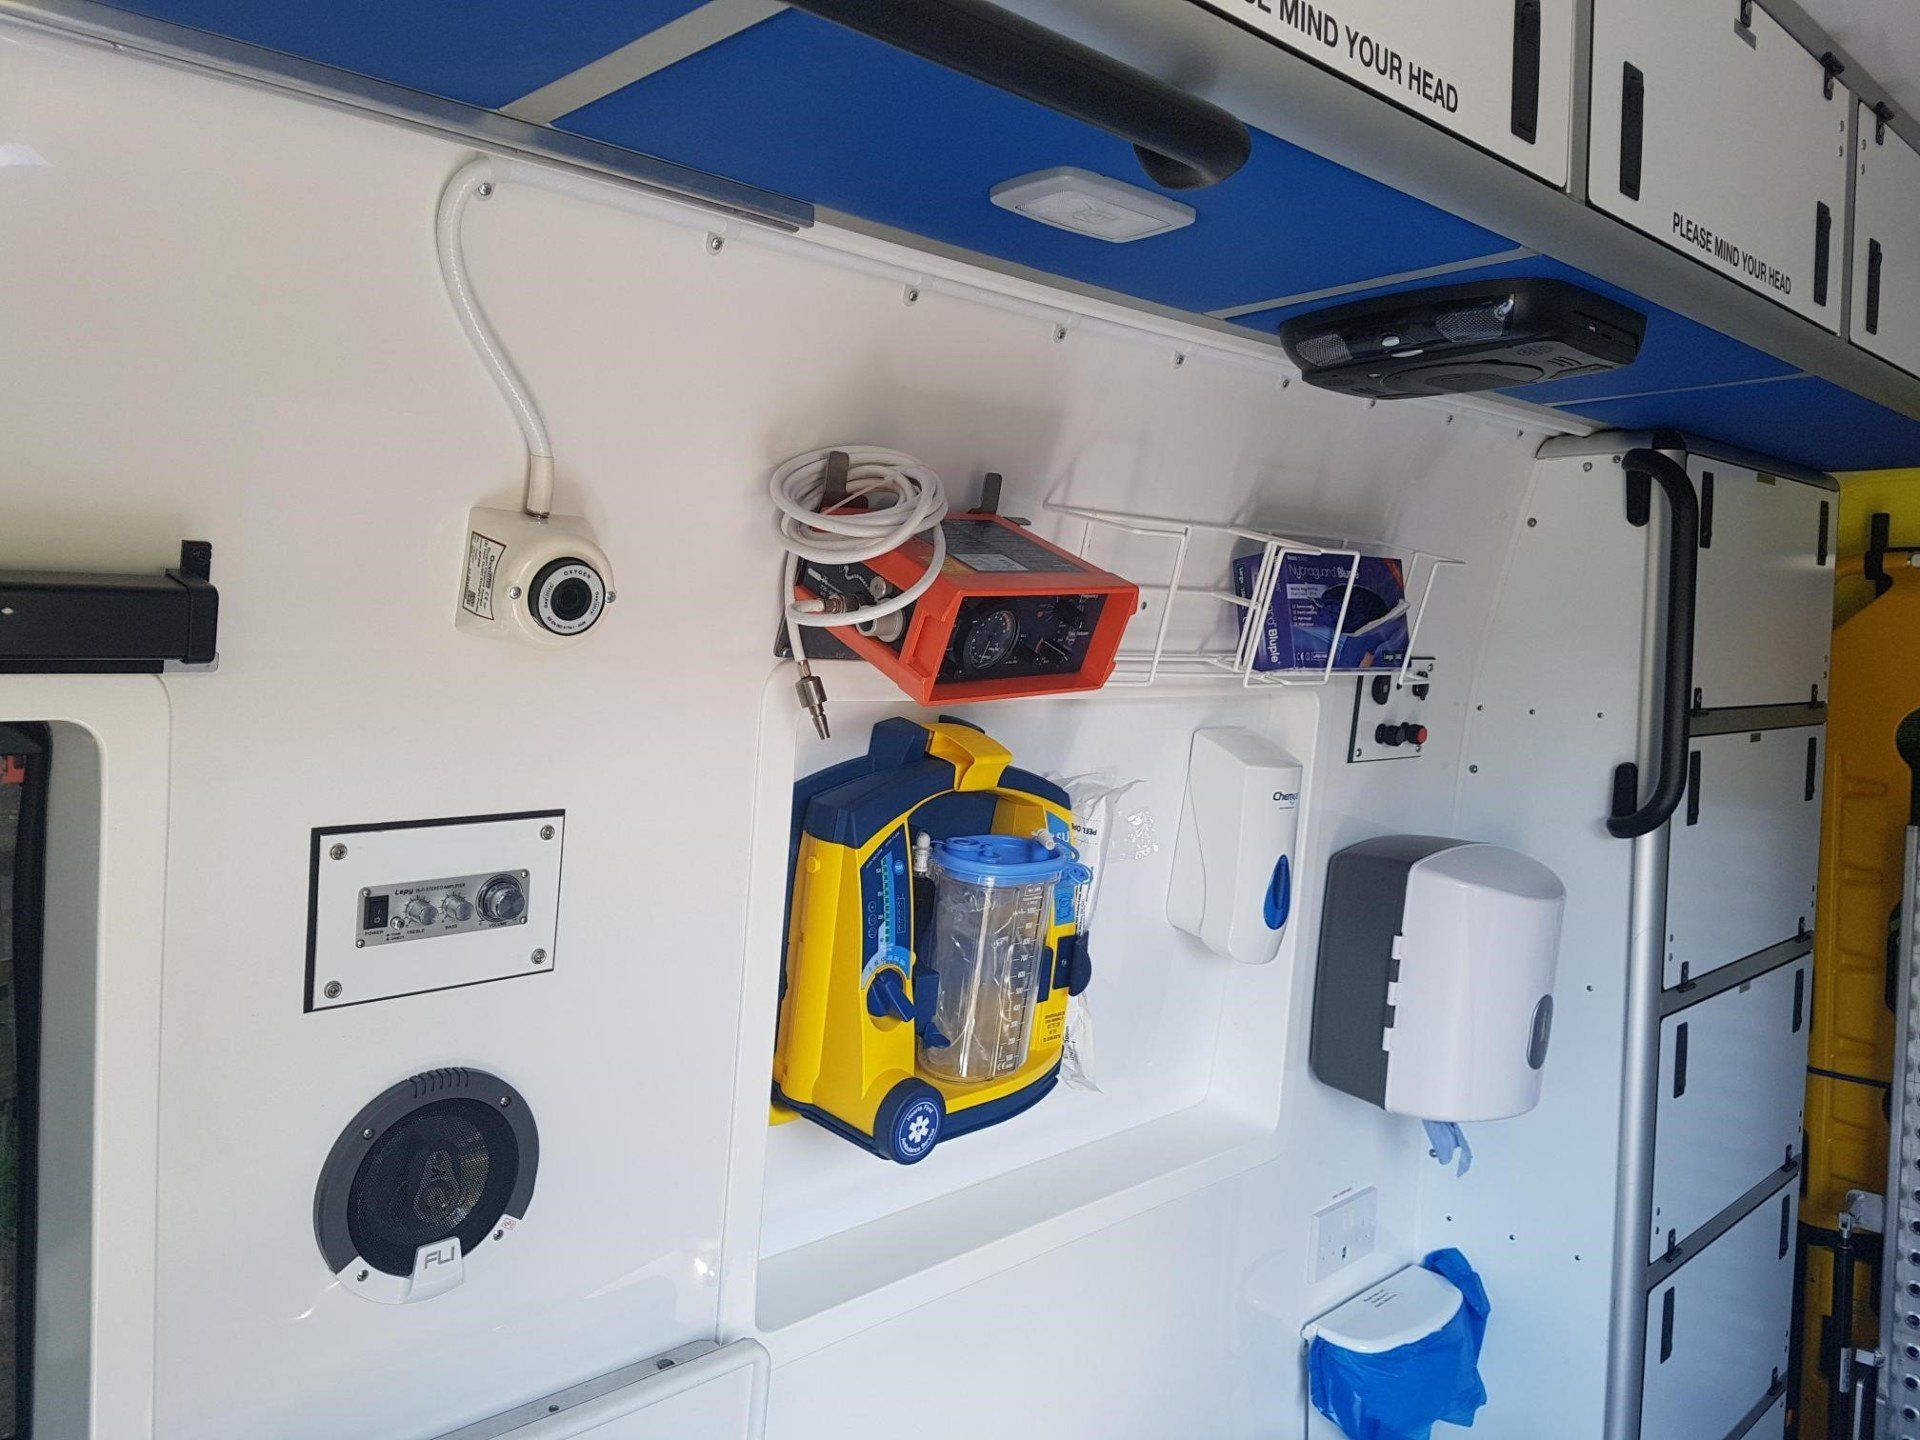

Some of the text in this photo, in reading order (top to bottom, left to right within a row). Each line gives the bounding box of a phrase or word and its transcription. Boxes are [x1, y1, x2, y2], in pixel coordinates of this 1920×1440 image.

[1279, 0, 1459, 113] MIND YOUR HEAD
[1672, 211, 1792, 295] PLEASE MIND YOUR HEAD
[563, 569, 591, 579] OXYGEN
[394, 888, 414, 897] Lepy
[424, 1246, 455, 1269] FLI
